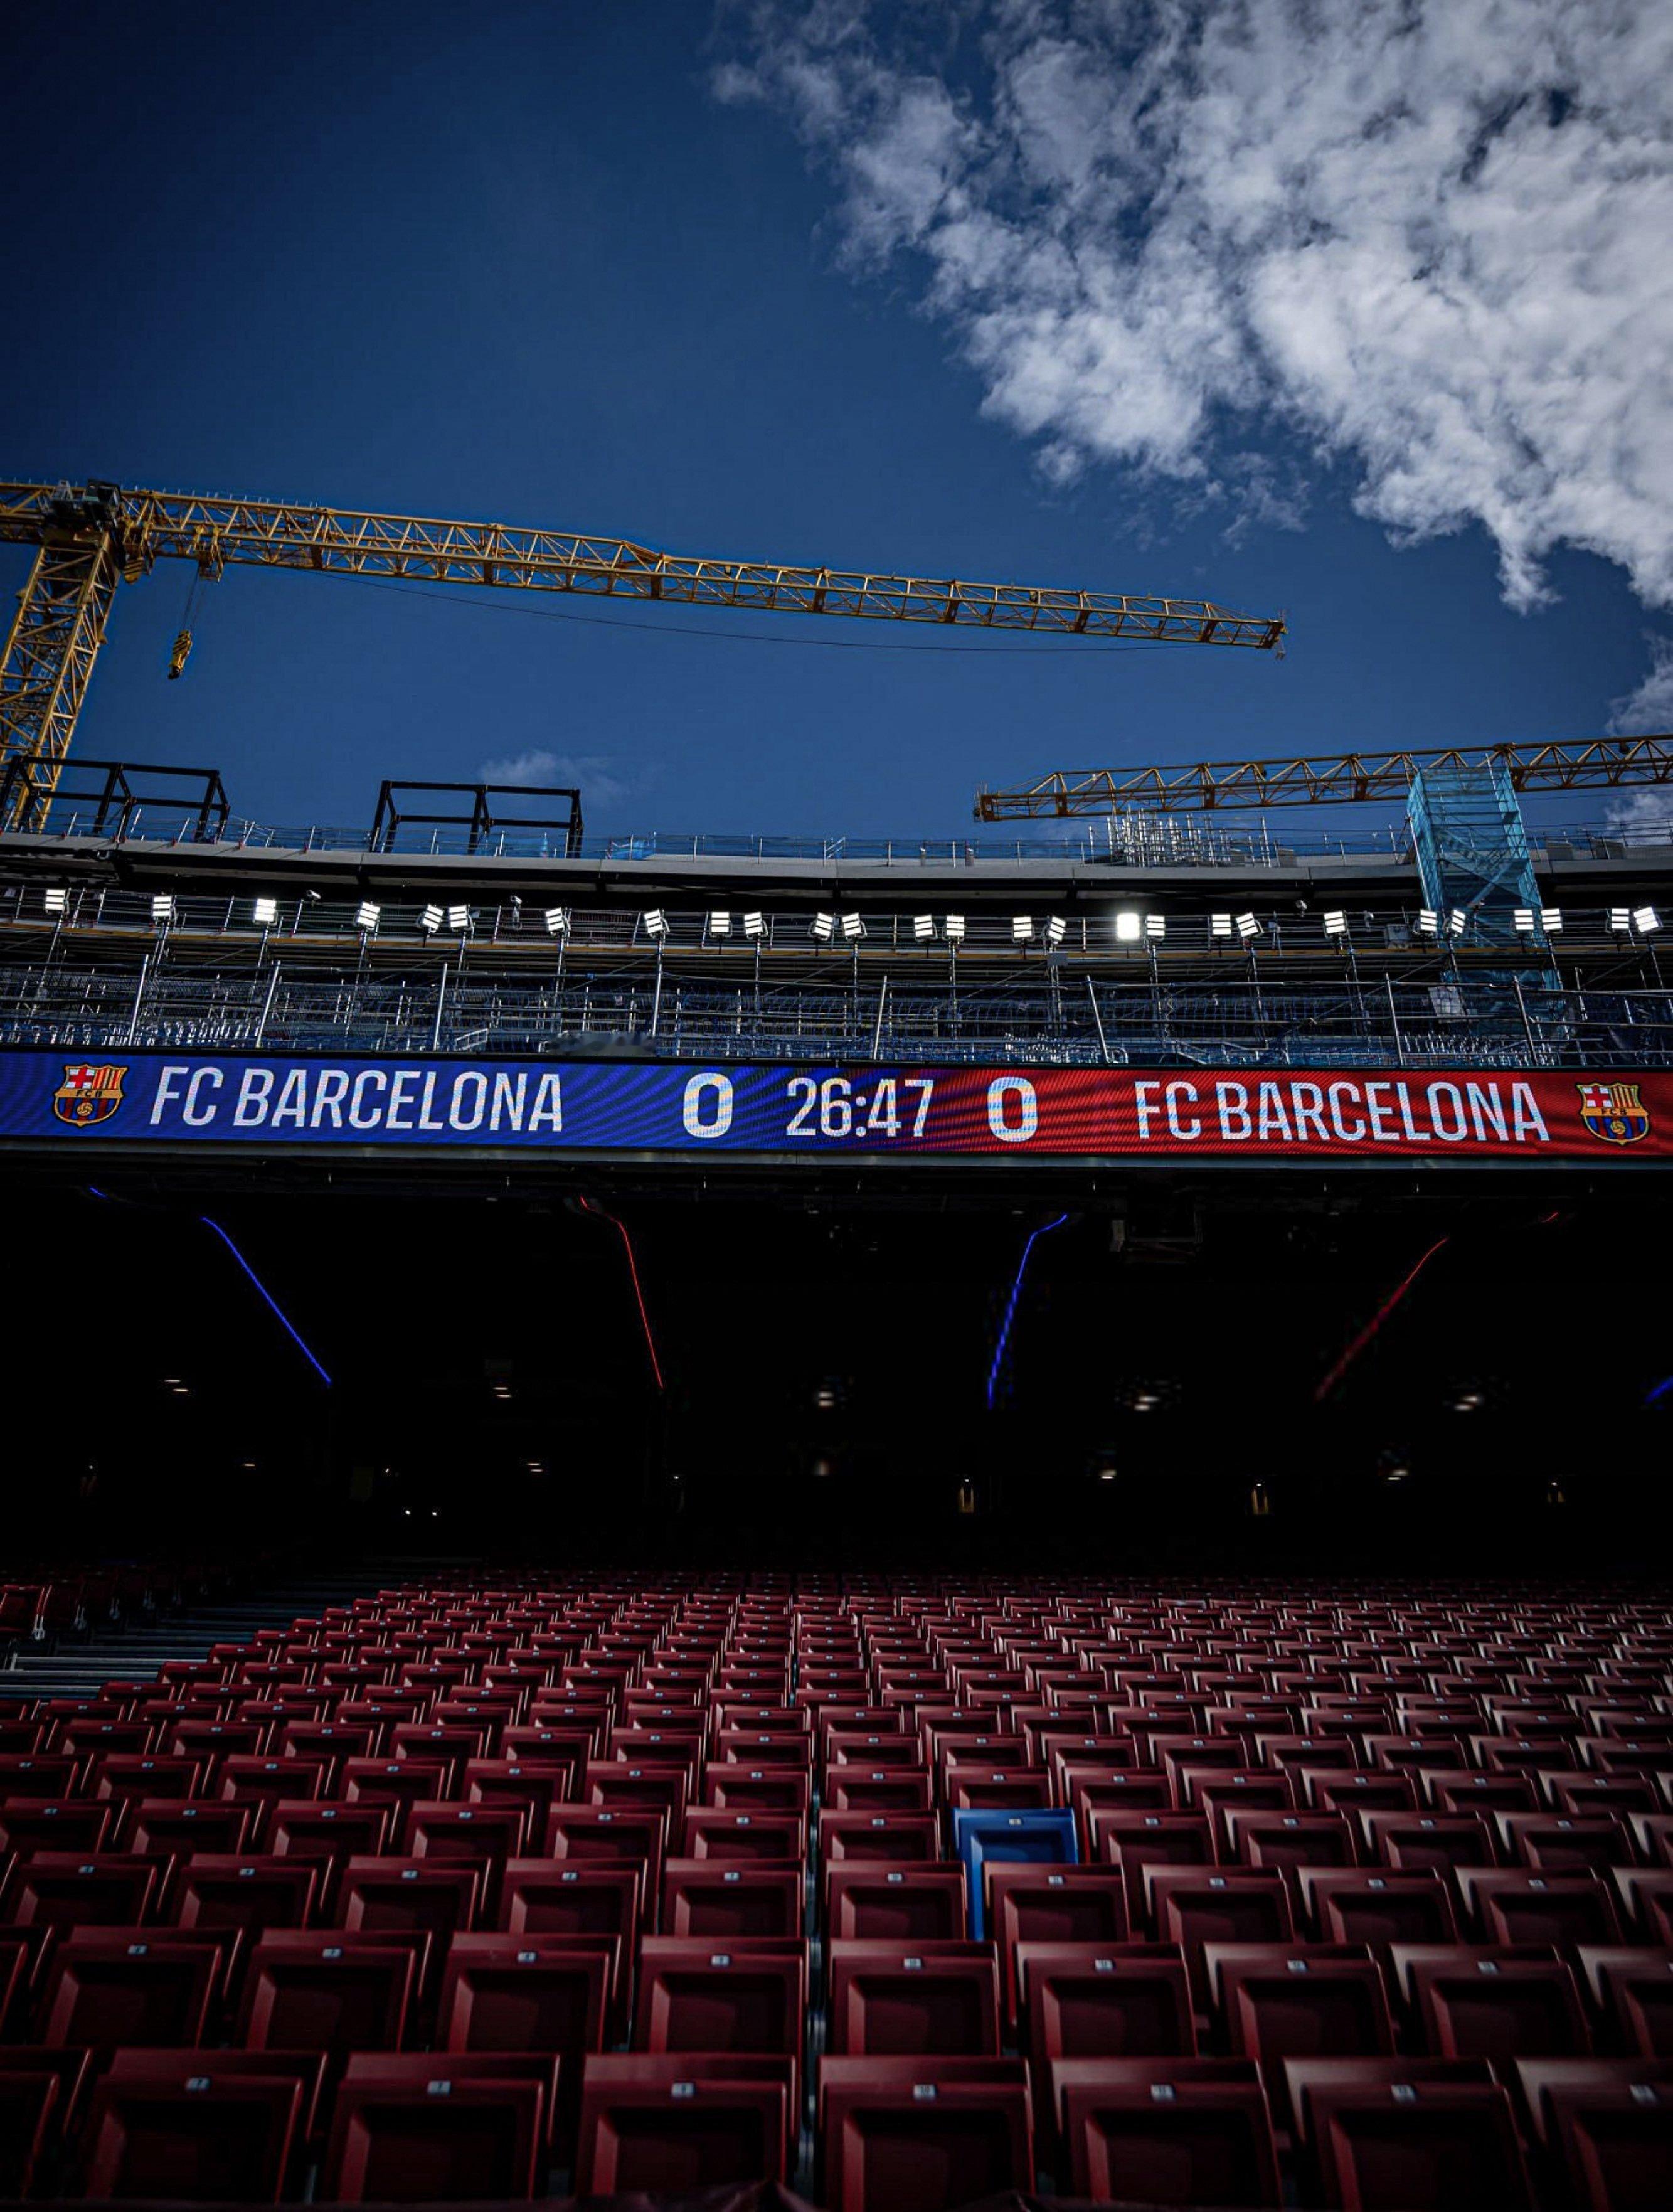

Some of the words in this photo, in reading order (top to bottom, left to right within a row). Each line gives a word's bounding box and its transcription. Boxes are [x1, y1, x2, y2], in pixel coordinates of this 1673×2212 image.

[150, 1066, 224, 1126] FC
[233, 1068, 563, 1132] BARCELONA
[682, 1072, 733, 1139] 0
[787, 1077, 933, 1137] 26:47
[987, 1076, 1038, 1142] 0
[1134, 1080, 1201, 1140] FC
[1215, 1081, 1551, 1142] BARCELONA
